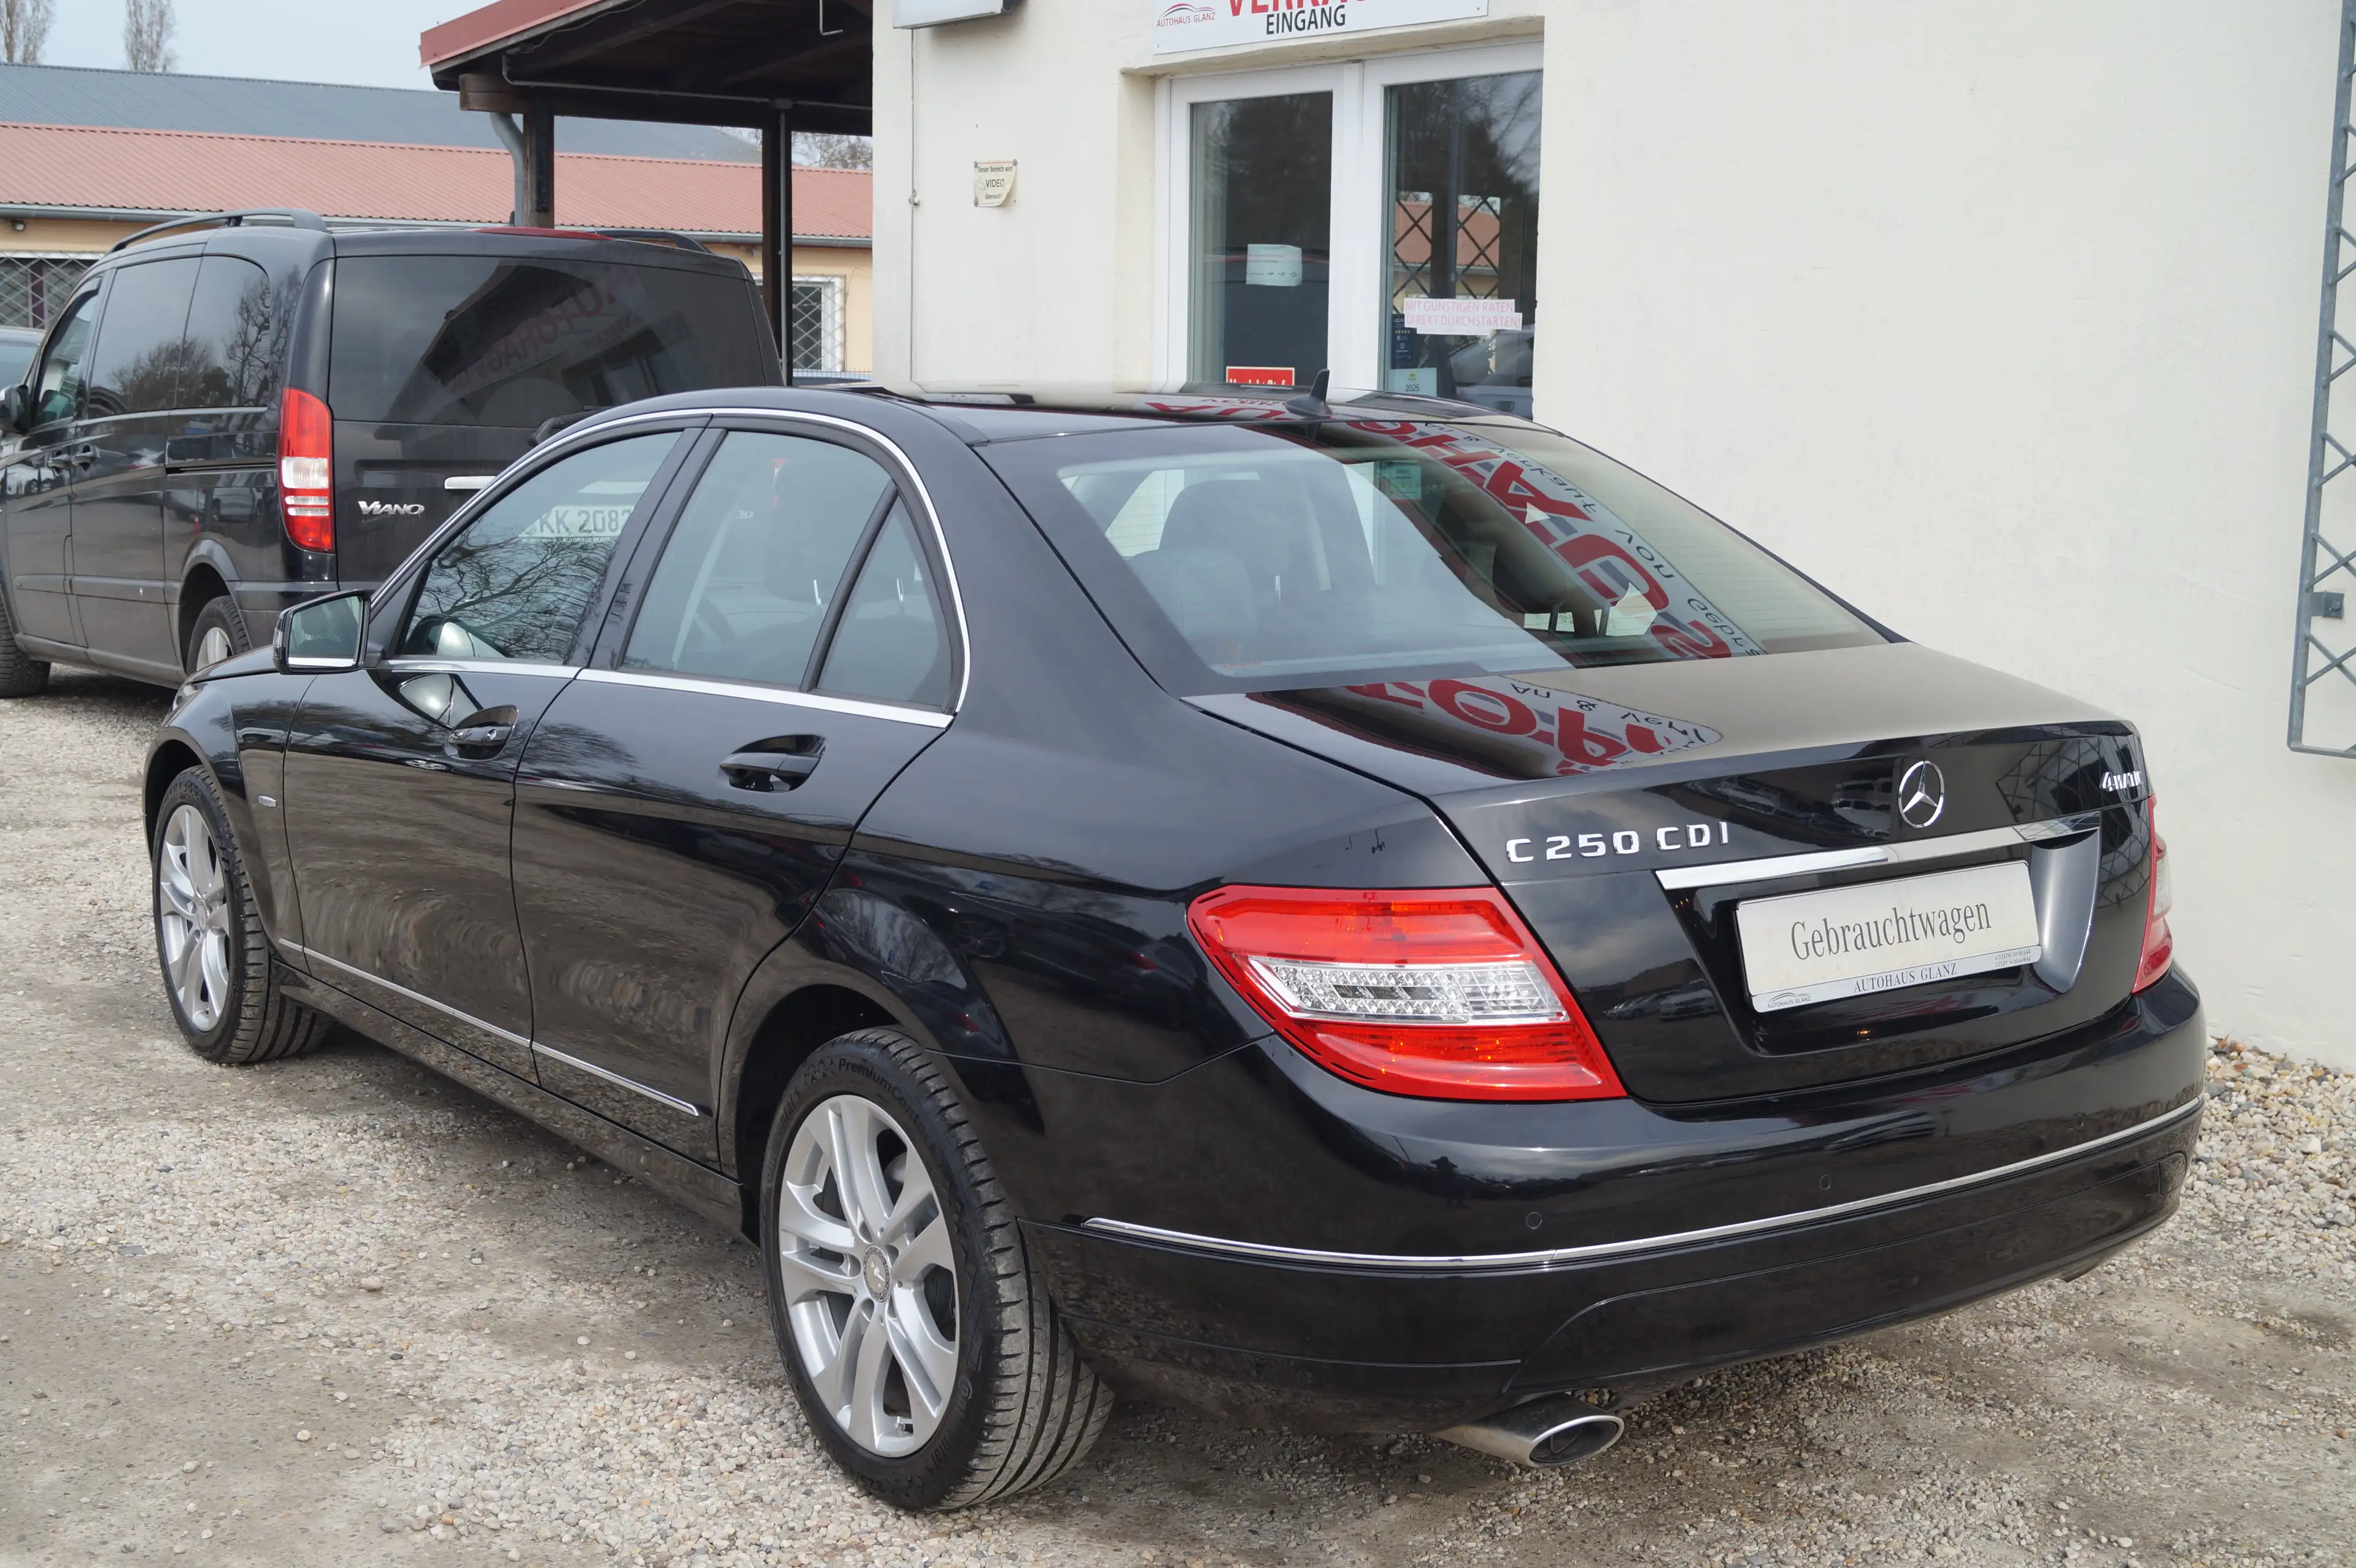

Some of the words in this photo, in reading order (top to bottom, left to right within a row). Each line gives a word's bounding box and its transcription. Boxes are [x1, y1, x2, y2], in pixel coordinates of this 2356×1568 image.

[1157, 16, 1191, 27] AUTOHAUS
[1193, 12, 1215, 23] GLANZ
[1266, 5, 1345, 35] EINGANG
[985, 179, 1005, 187] VIDEO
[1406, 301, 1422, 312] MIT
[1423, 299, 1480, 312] GÜNSTIGEN
[1482, 301, 1514, 313] RATEN
[1407, 313, 1440, 326] DIREKT
[1441, 315, 1521, 328] DURCHSTARTEN!
[1506, 838, 1534, 863] C
[1546, 830, 1640, 861] 250
[1657, 821, 1729, 851] CDI
[1791, 902, 1992, 961] Gebrauchtwagen
[1853, 972, 1915, 993] AUTOHAUS
[1920, 963, 1958, 982] GLANZ
[1766, 999, 1794, 1009] AUTOHAUS
